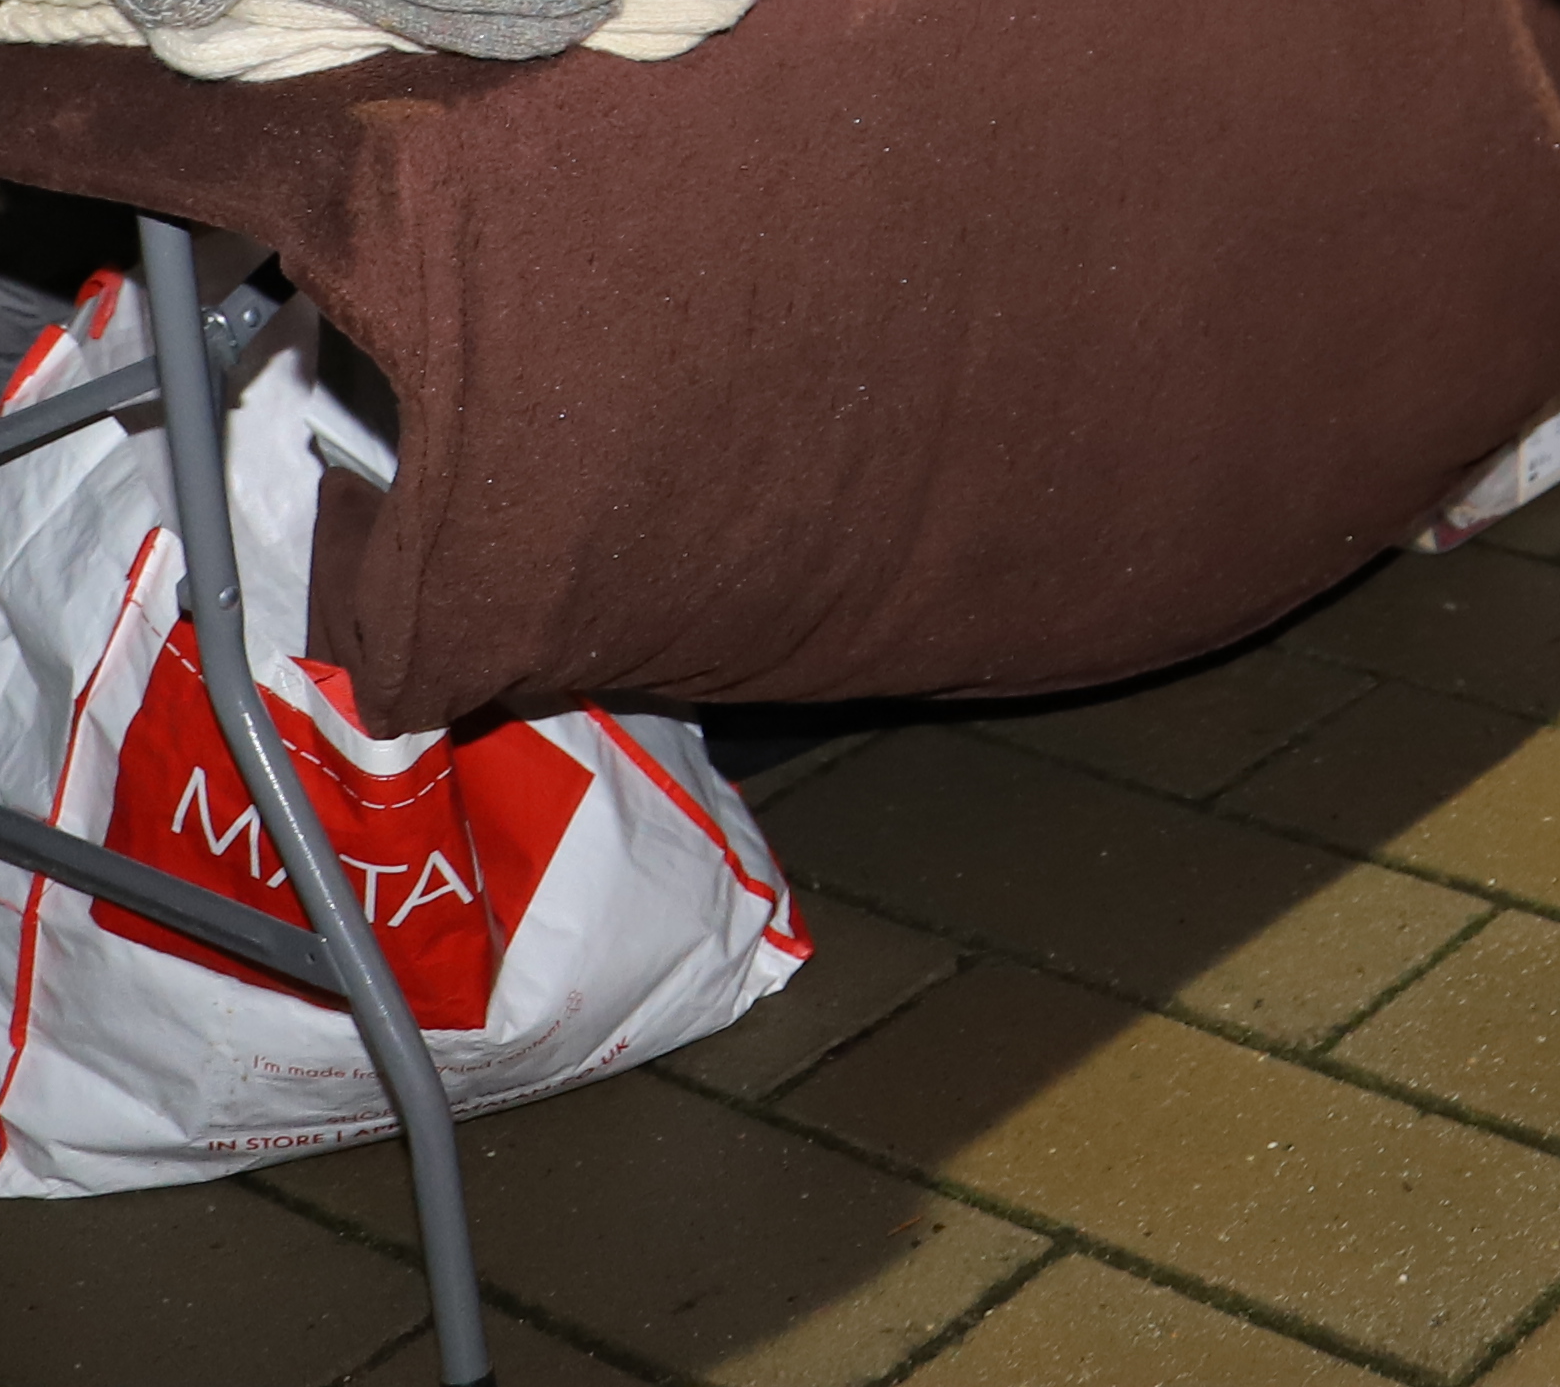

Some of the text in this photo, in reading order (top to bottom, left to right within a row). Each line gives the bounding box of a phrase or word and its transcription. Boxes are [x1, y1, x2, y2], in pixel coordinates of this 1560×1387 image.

[170, 765, 484, 928] MTA
[252, 1055, 281, 1074] I'm
[287, 1066, 346, 1080] made
[352, 1068, 382, 1081] fro
[208, 1139, 236, 1152] IN
[246, 1133, 325, 1151] STORE
